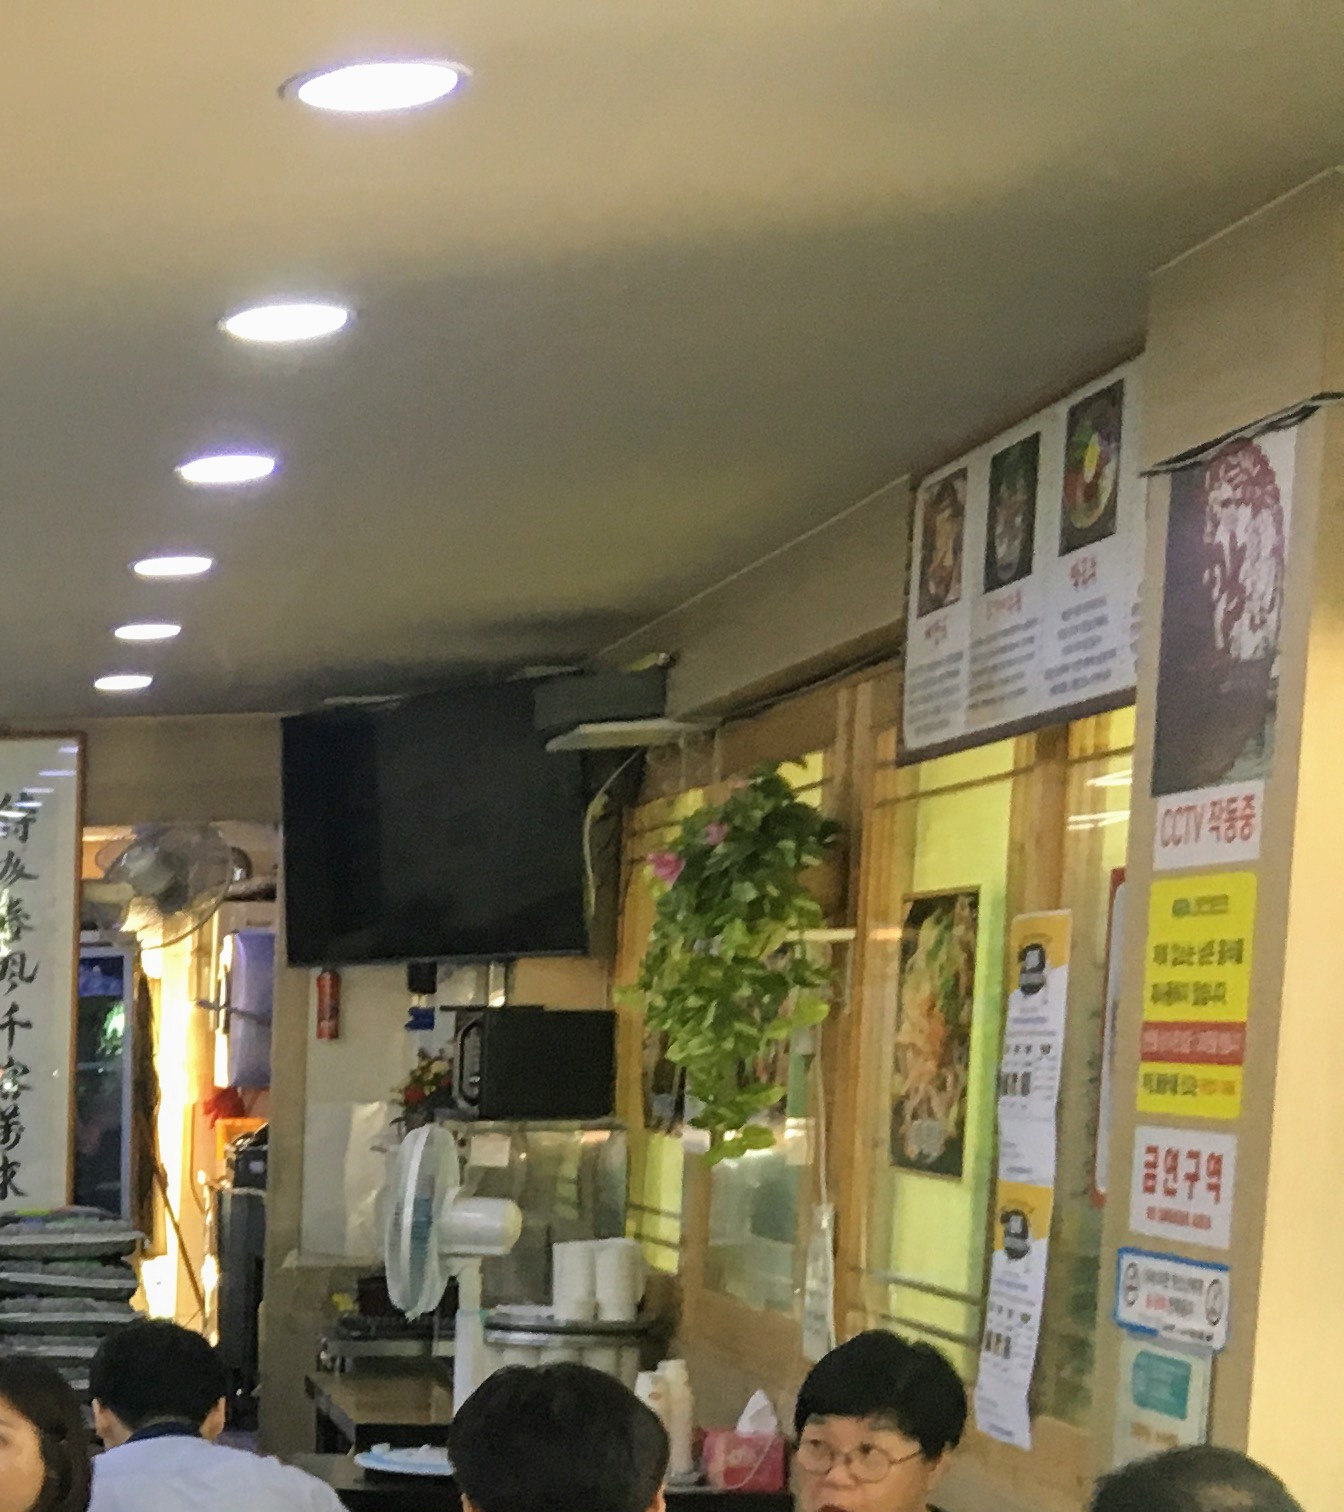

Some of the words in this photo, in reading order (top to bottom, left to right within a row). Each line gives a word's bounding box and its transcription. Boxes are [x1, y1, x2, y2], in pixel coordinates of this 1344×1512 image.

[1159, 805, 1205, 848] CCTV
[1208, 793, 1255, 844] 작동중
[1142, 1145, 1224, 1204] 금연구역
